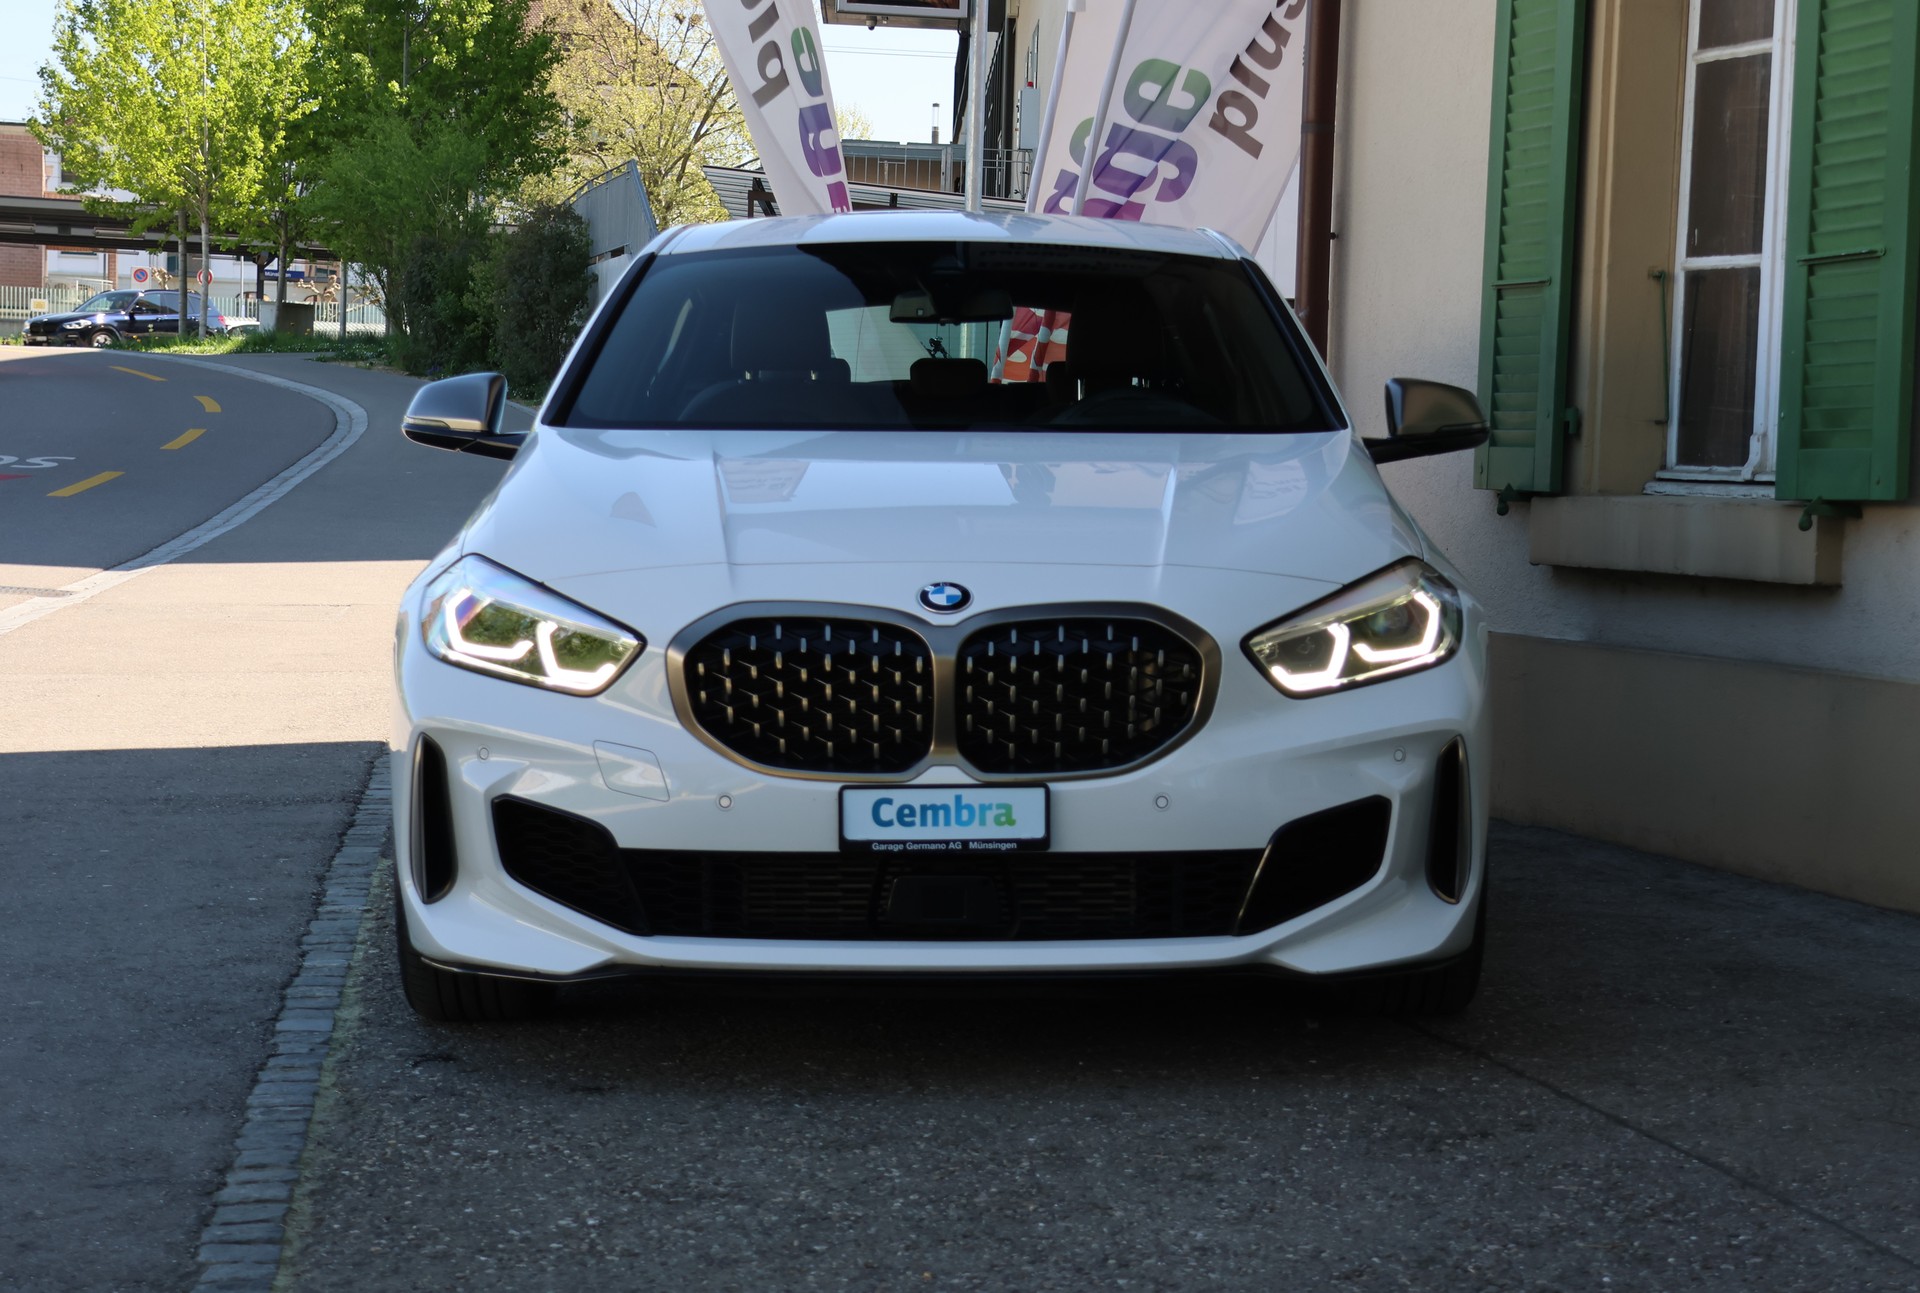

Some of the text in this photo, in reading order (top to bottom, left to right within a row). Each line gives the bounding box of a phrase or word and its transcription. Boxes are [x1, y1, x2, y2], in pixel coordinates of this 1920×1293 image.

[872, 794, 1016, 827] Cembra
[872, 841, 1017, 851] Garage Germano AG Münsingen
